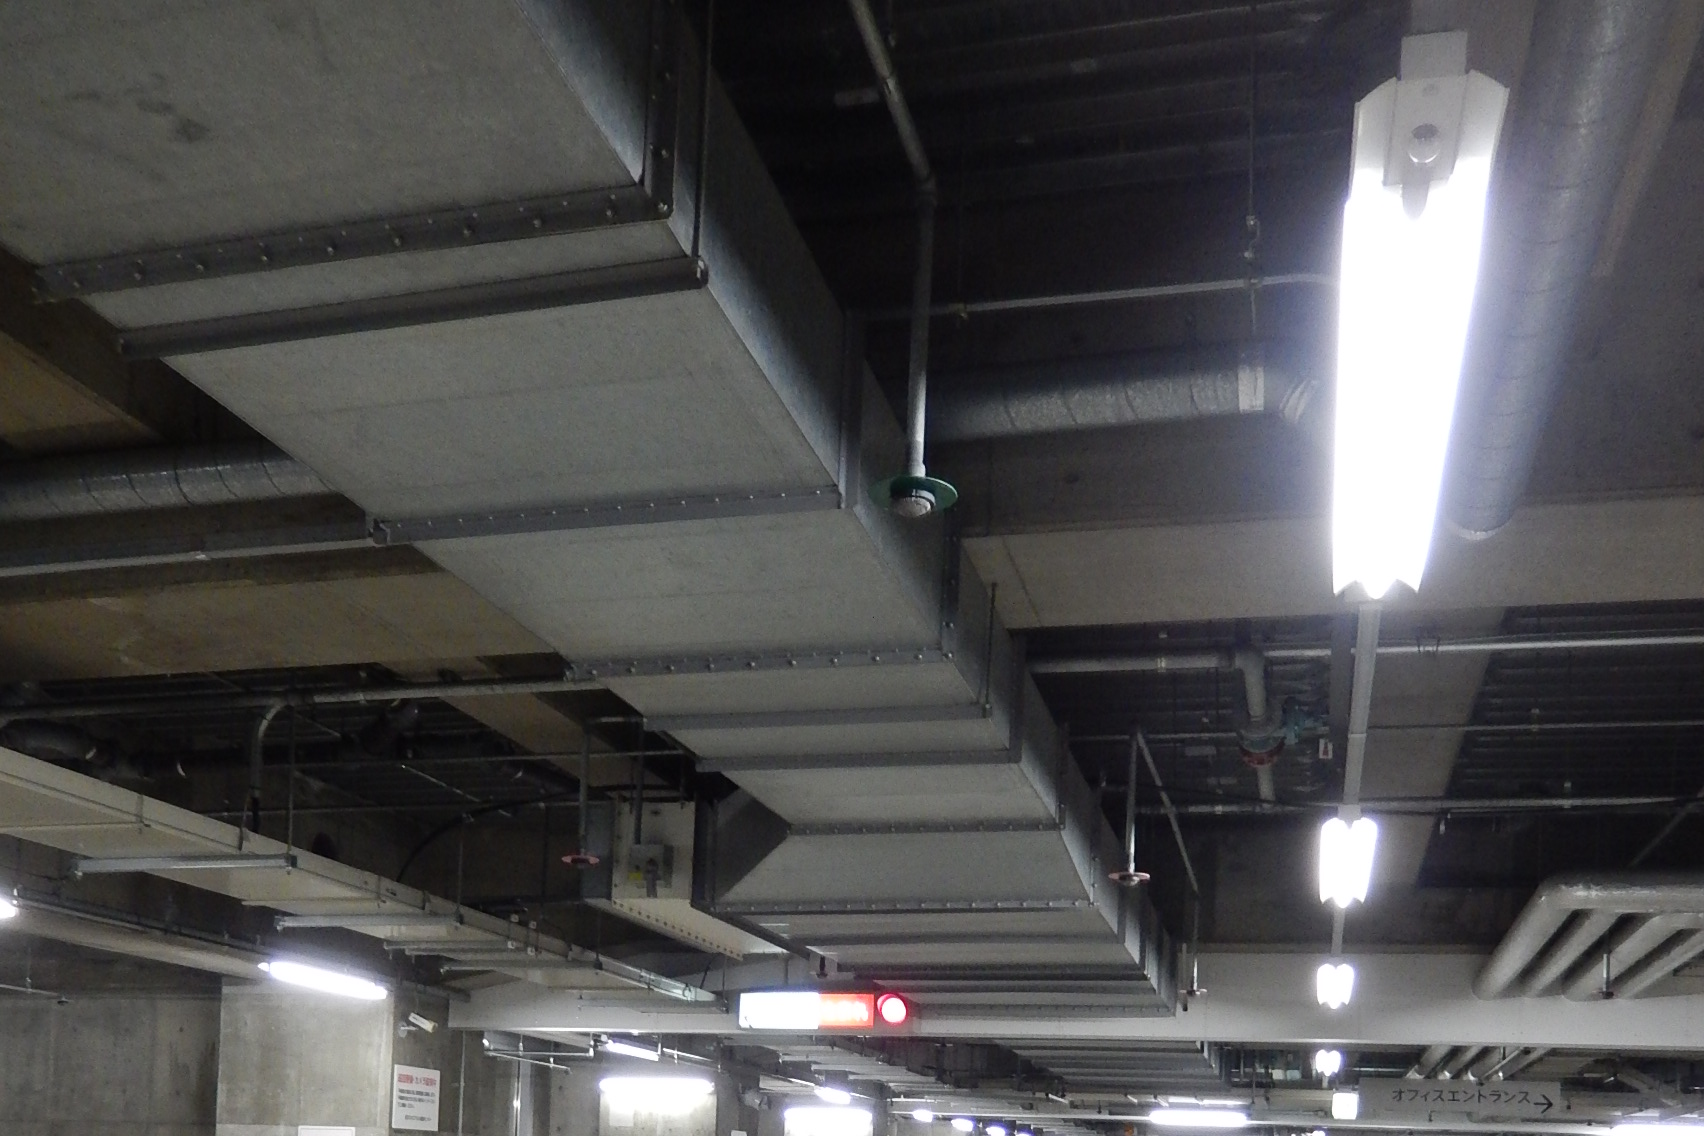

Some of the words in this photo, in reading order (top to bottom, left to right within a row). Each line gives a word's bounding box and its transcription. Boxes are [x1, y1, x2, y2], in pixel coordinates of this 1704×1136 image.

[1392, 1088, 1531, 1104] オフィスエントランス
